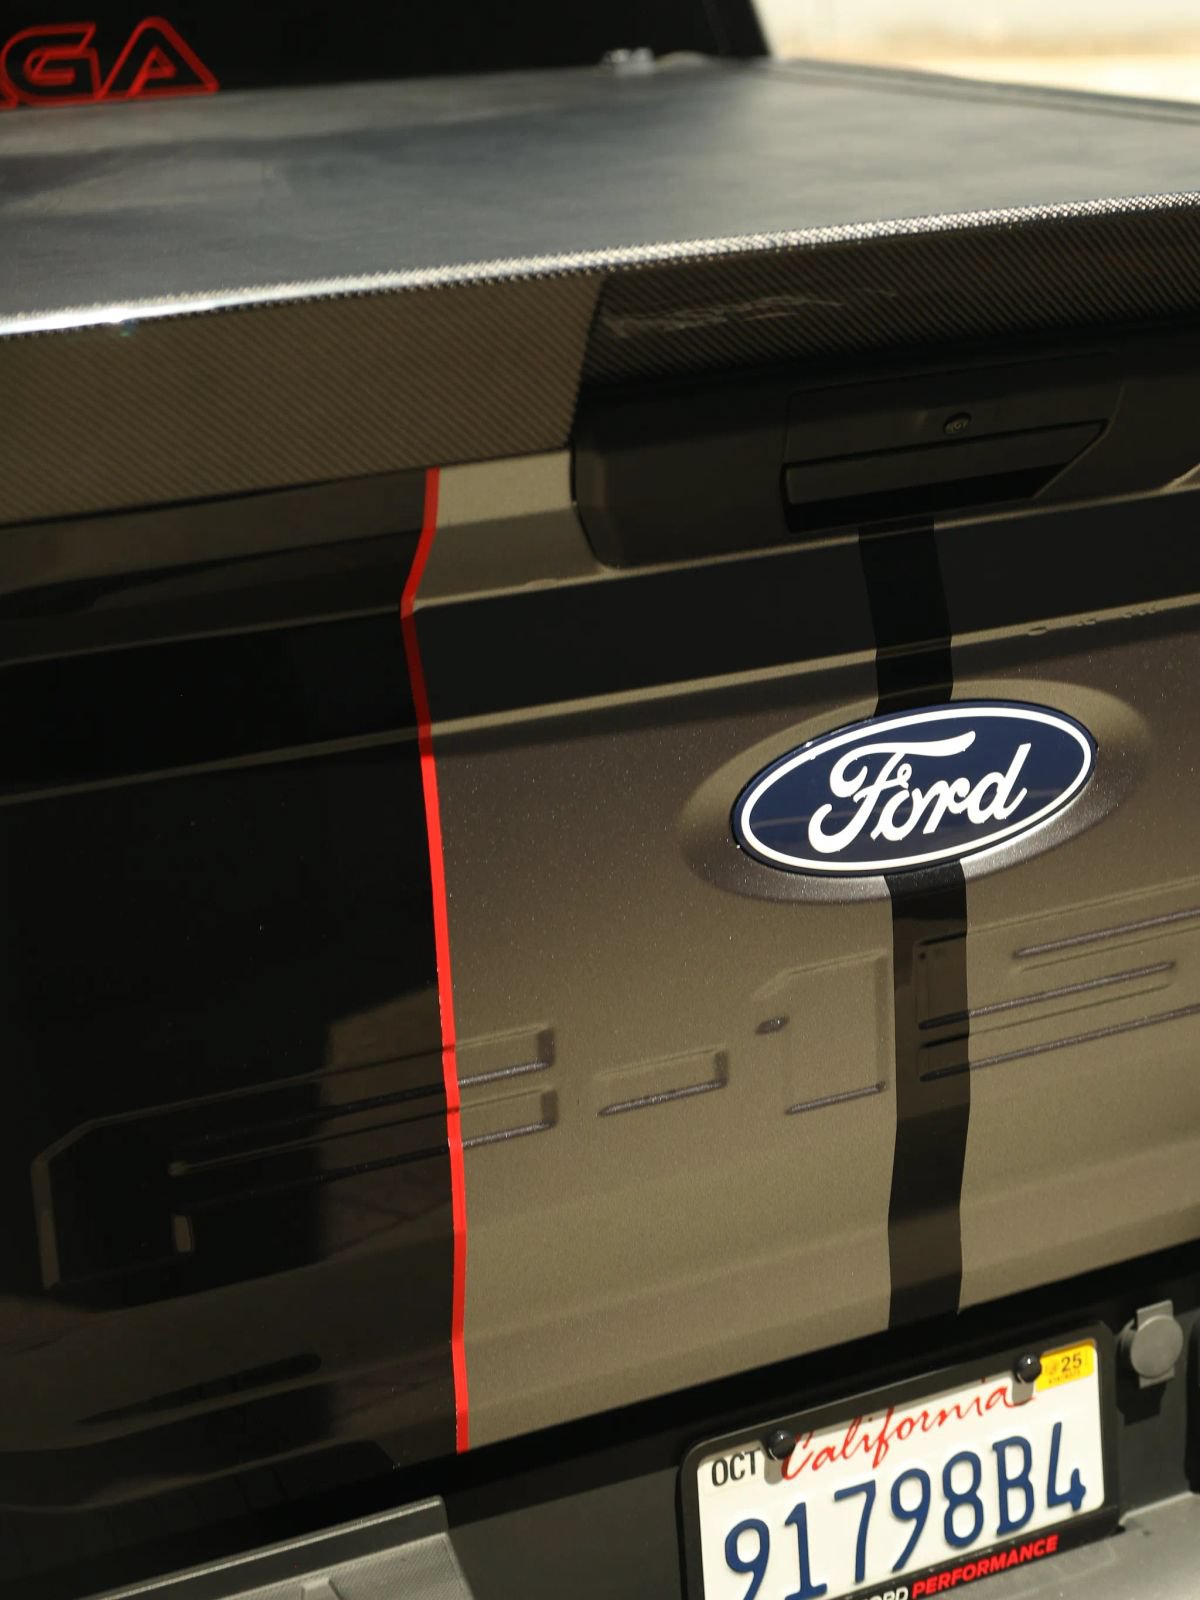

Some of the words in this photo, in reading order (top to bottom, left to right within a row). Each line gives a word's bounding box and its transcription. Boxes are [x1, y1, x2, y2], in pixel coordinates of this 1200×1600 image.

[0, 16, 219, 108] GA
[808, 731, 1032, 853] Ford
[1061, 1352, 1082, 1373] 25
[711, 1448, 761, 1487] OCT
[781, 1378, 1036, 1480] California
[724, 1421, 1087, 1600] 91798B4
[911, 1535, 1059, 1599] PERFORMANCE
